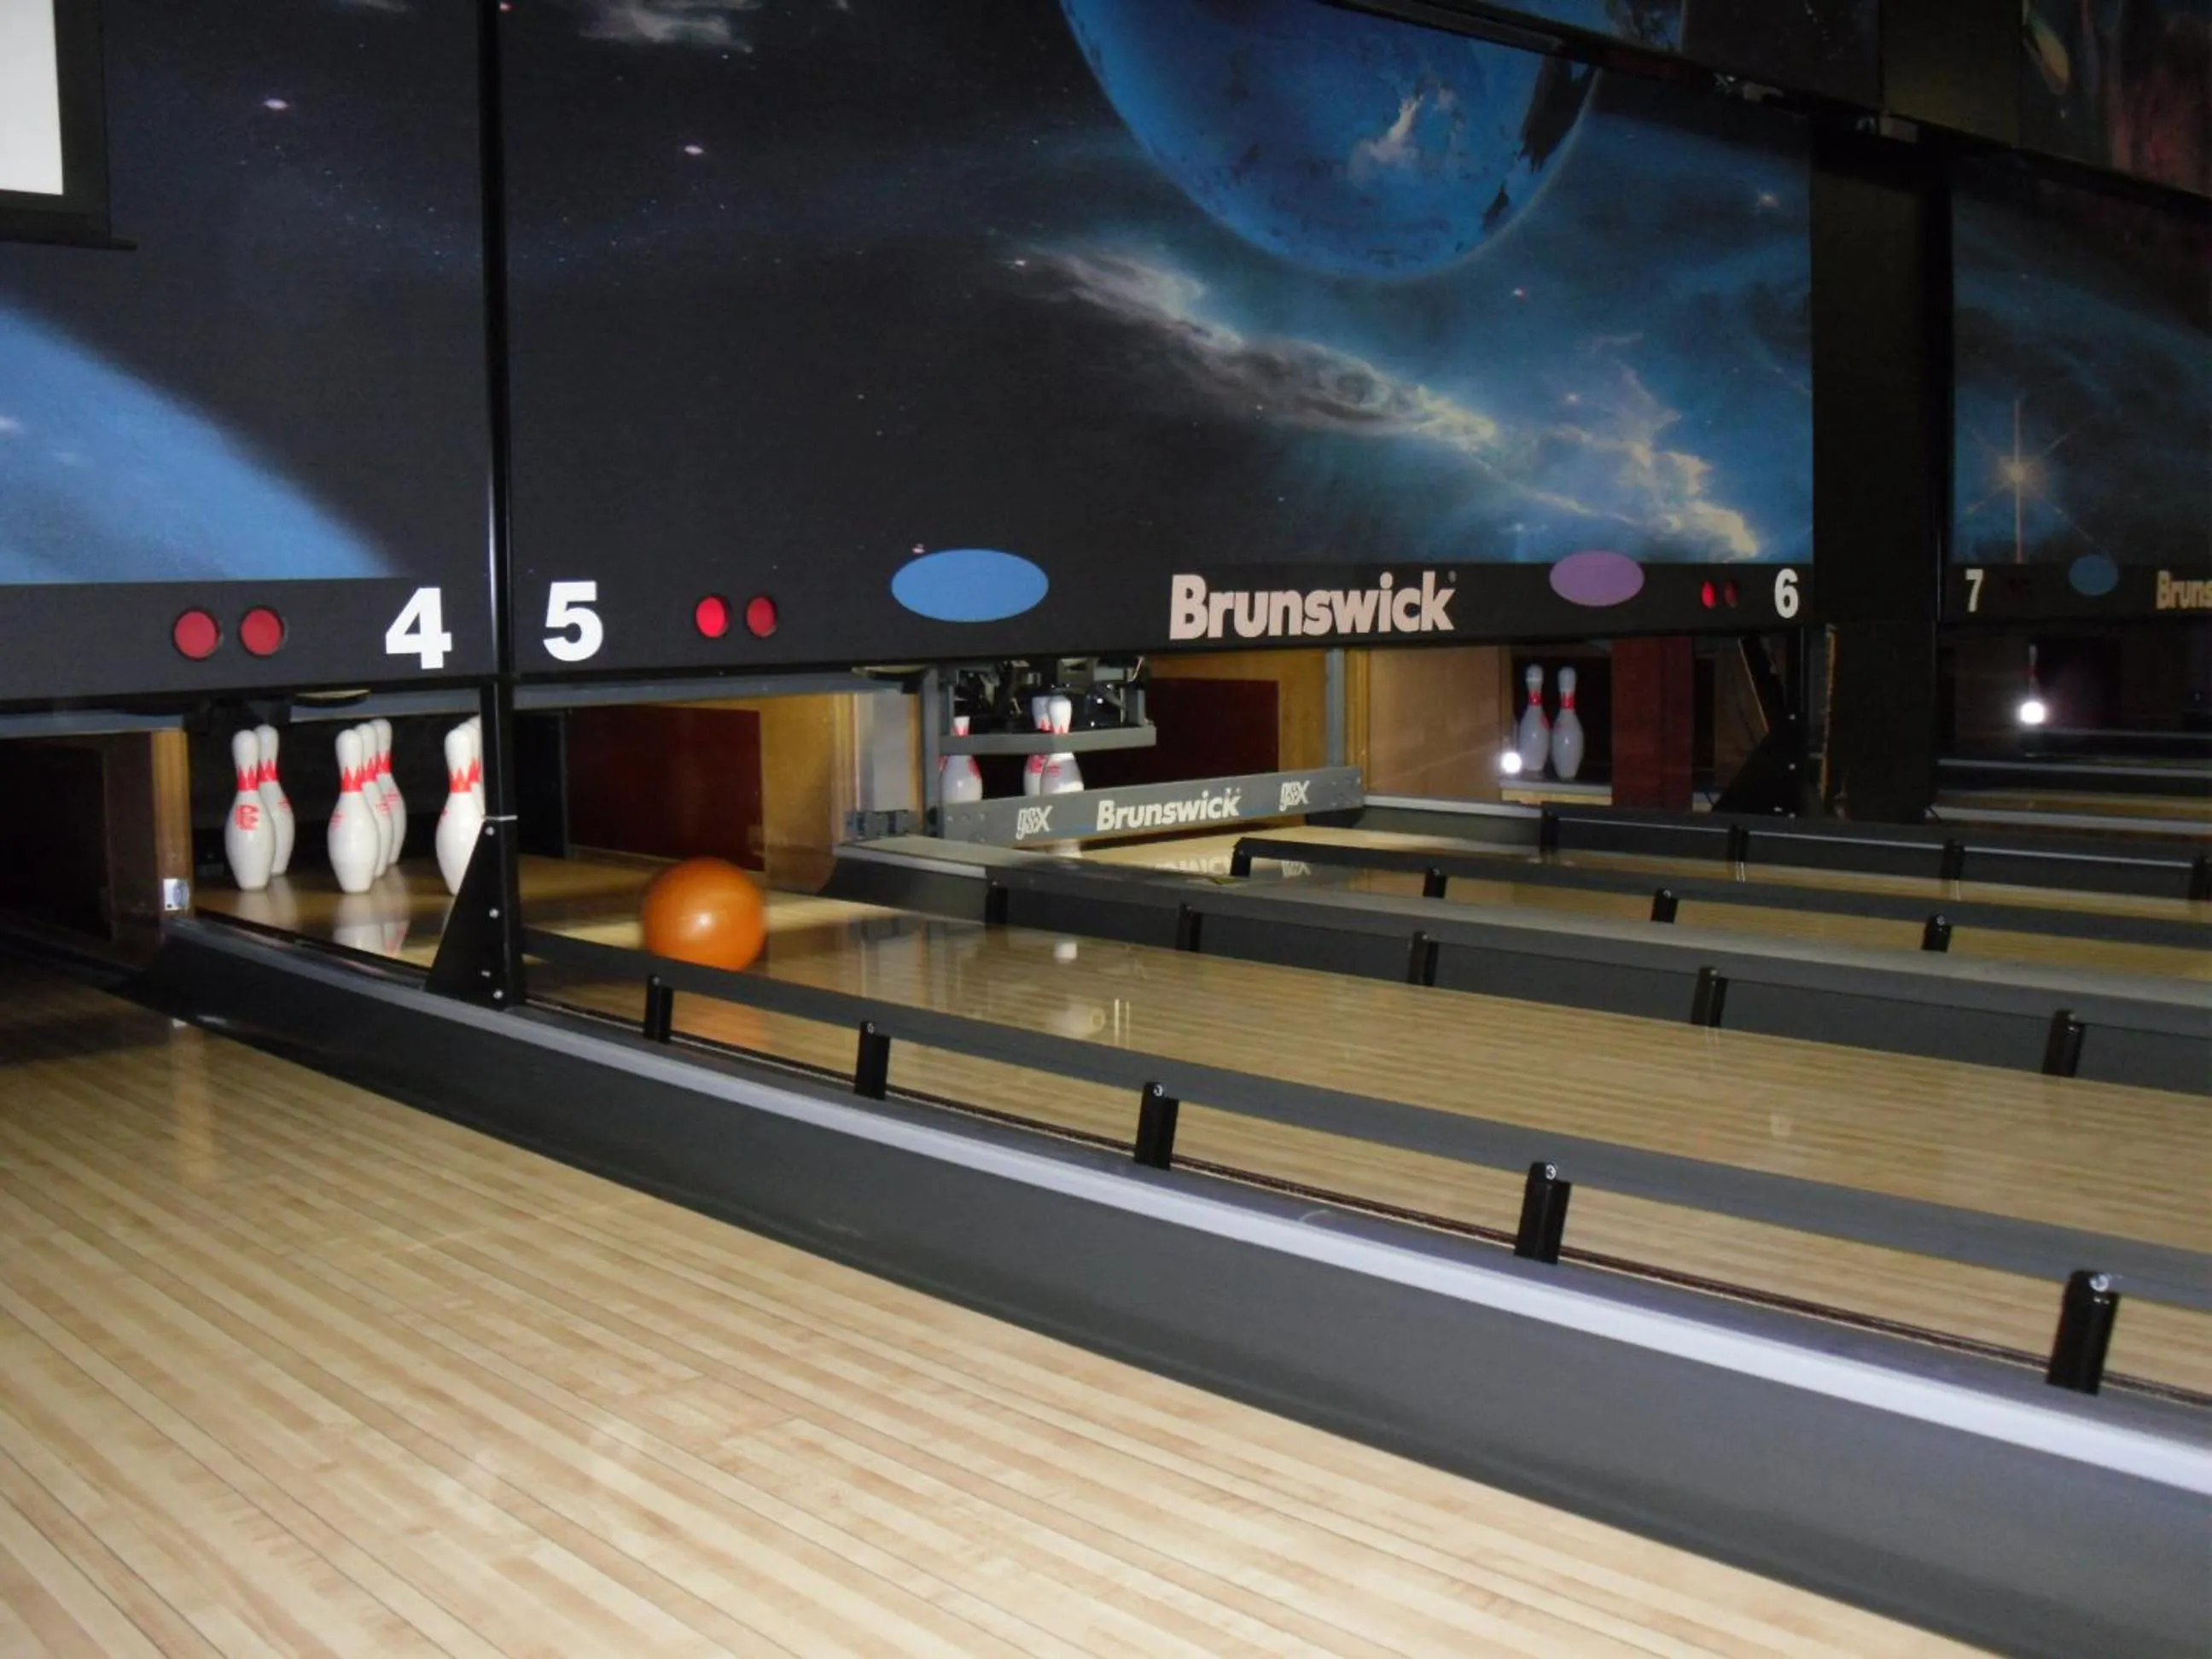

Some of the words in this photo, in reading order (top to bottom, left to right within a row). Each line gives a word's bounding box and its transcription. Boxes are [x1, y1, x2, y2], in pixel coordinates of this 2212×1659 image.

[1169, 571, 1456, 639] Brunswick
[1774, 568, 1800, 619] 6
[1965, 568, 1984, 613] 7
[385, 587, 452, 670] 4
[543, 580, 604, 661] 5
[1096, 788, 1242, 832] Brunswick
